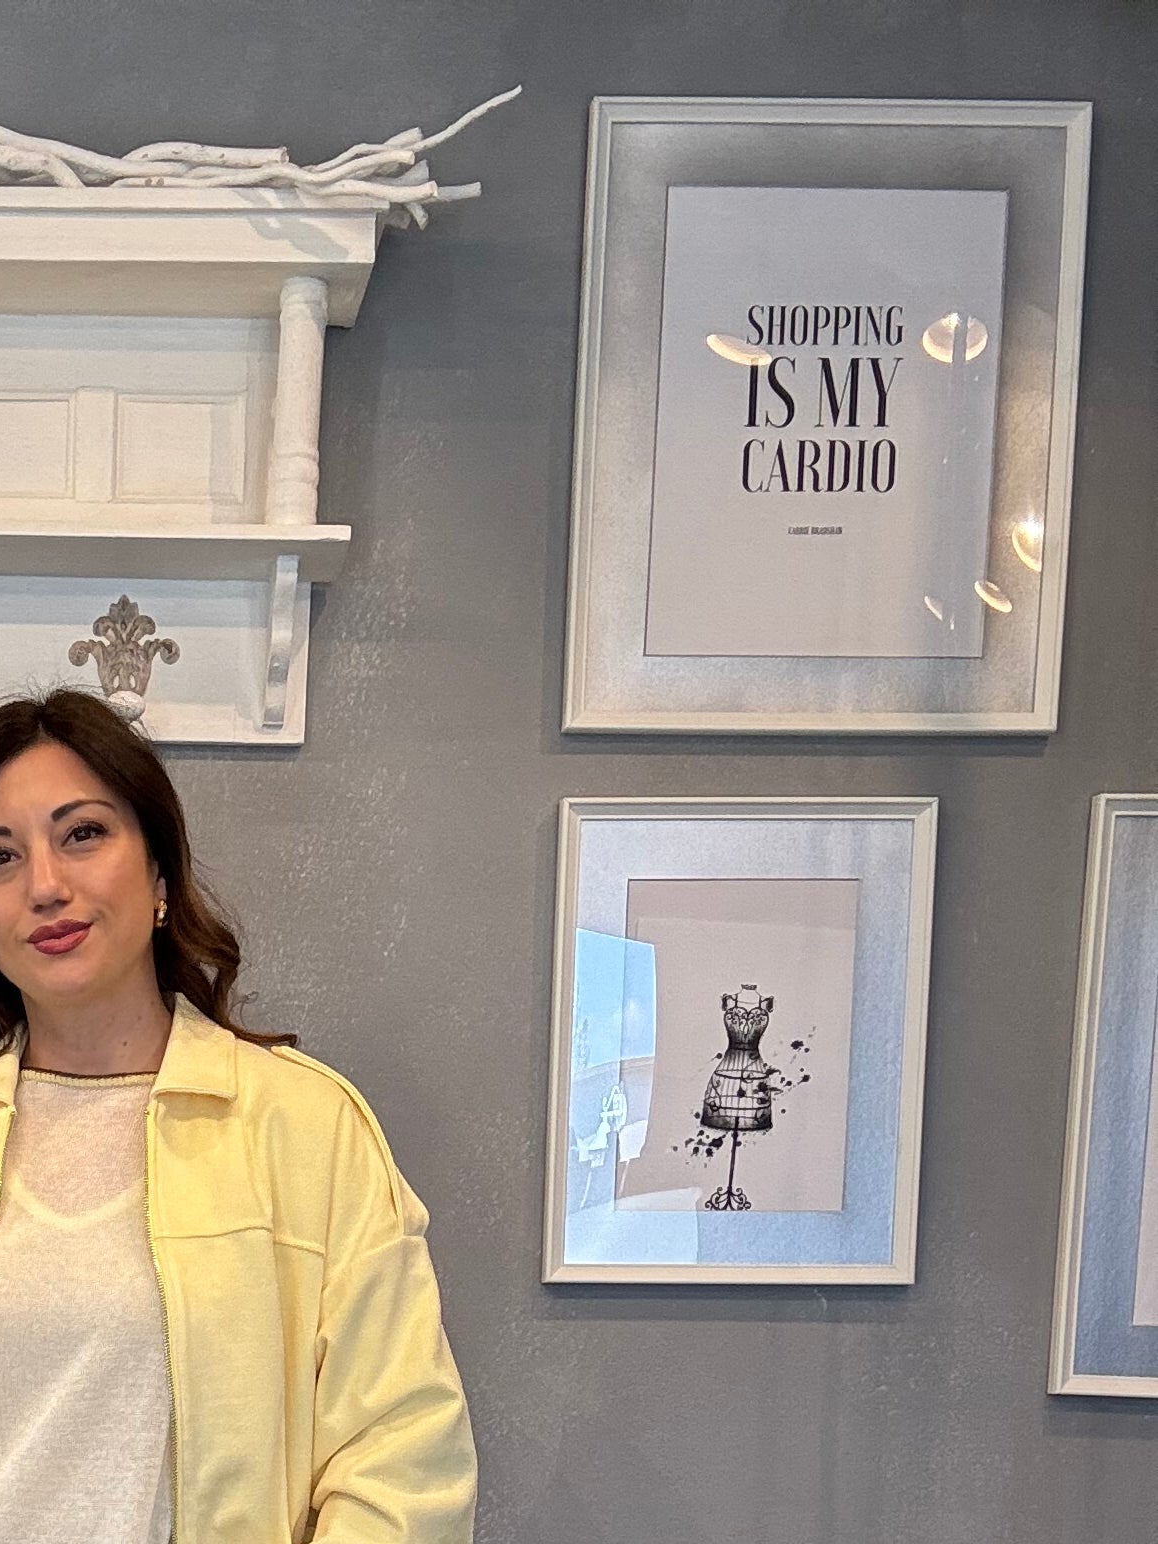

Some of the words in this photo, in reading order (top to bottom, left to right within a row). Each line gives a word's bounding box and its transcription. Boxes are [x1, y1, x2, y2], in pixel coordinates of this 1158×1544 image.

[746, 304, 905, 347] SHOPPING
[743, 356, 797, 429] IS
[813, 356, 904, 428] MY
[741, 438, 897, 494] CARDIO
